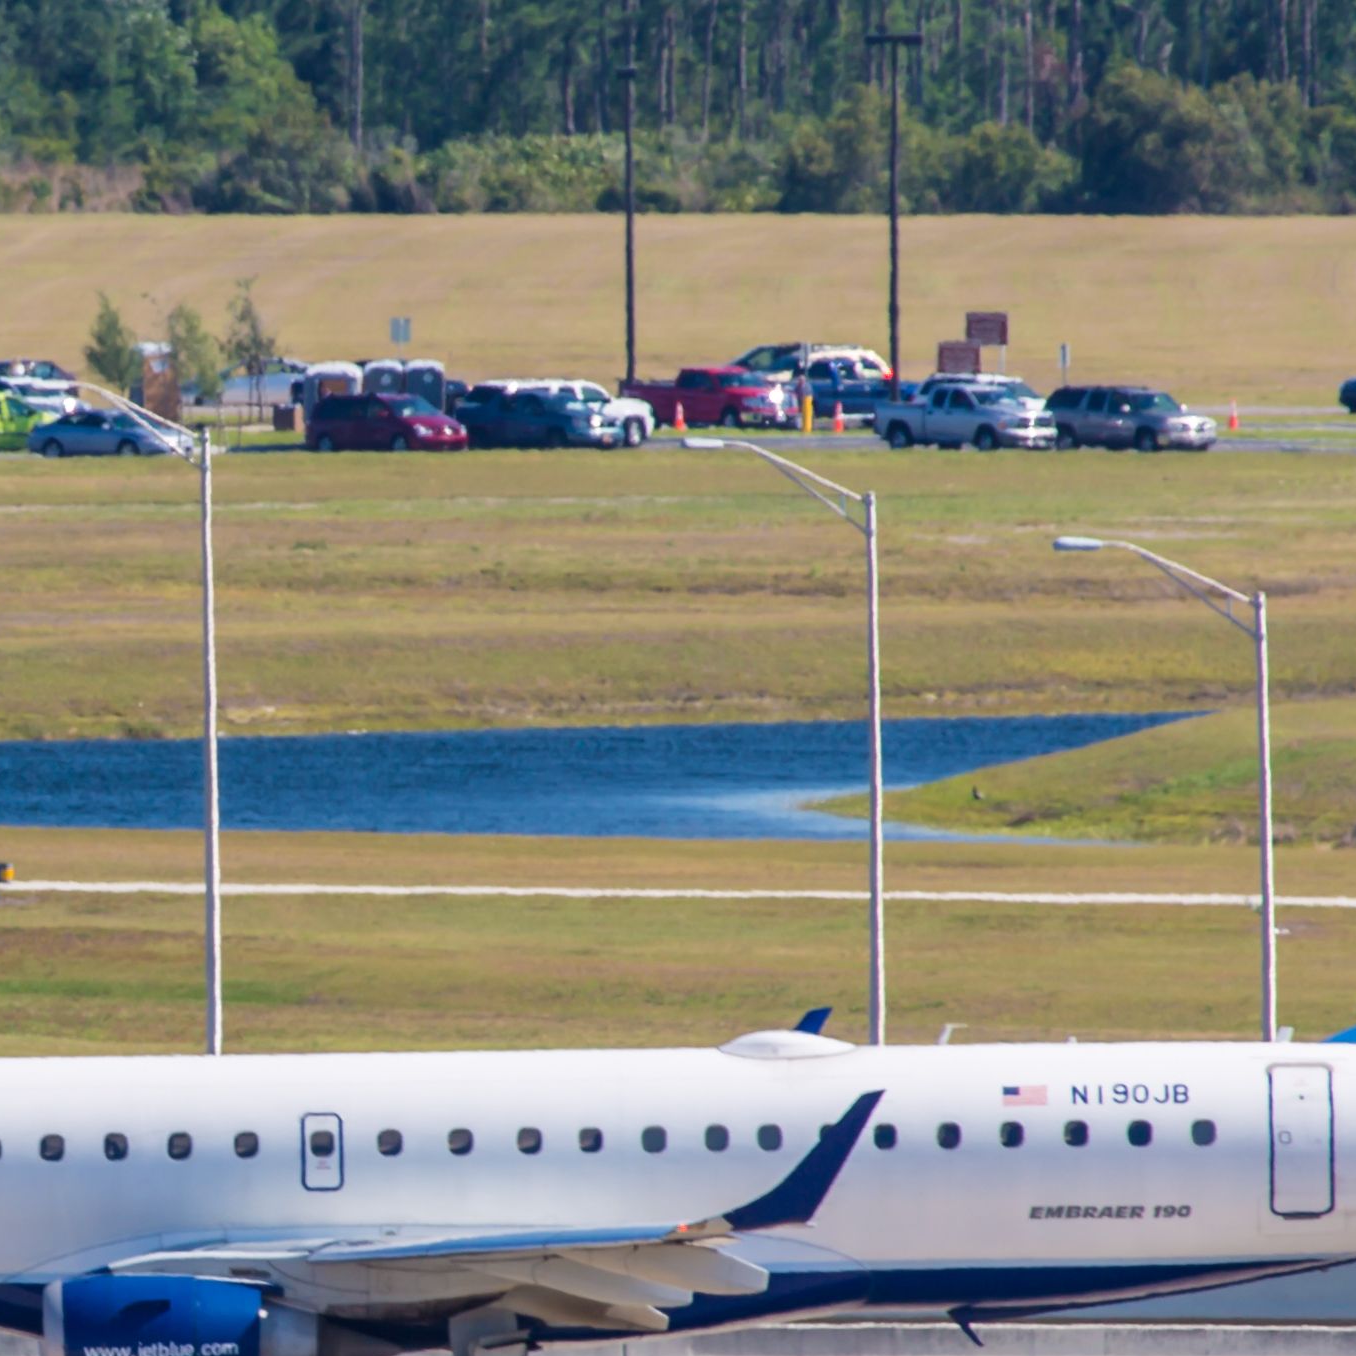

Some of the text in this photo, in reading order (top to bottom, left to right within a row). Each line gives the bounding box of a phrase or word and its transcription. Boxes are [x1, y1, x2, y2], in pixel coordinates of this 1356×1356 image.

[1071, 1083, 1190, 1105] N190JB
[1029, 1204, 1192, 1219] EMBRAER 190
